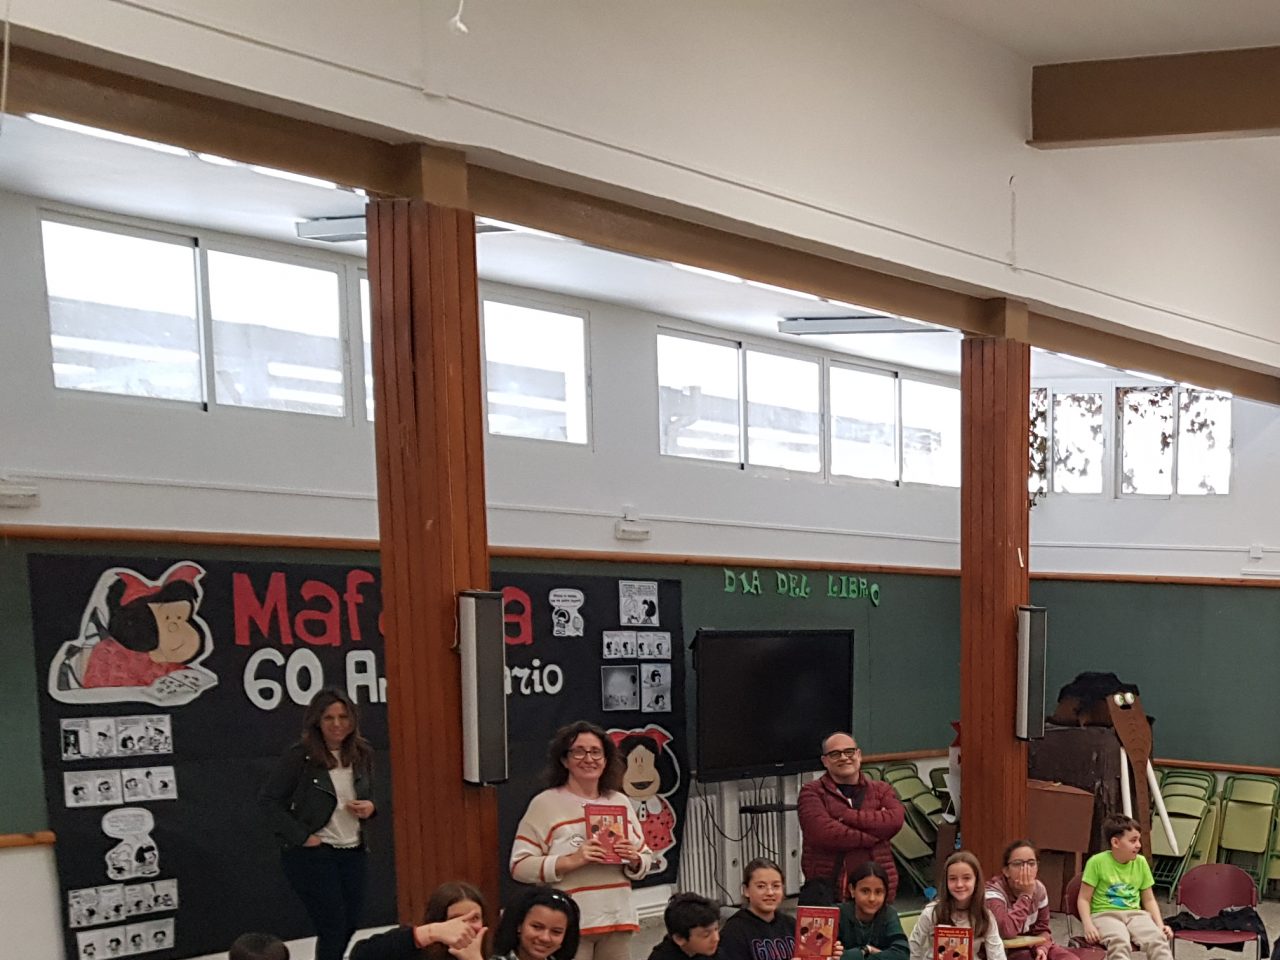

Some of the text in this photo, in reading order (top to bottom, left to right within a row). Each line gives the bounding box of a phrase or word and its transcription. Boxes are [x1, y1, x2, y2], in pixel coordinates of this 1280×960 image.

[723, 568, 880, 607] DIA DEL LIBRO
[243, 647, 324, 711] 60
